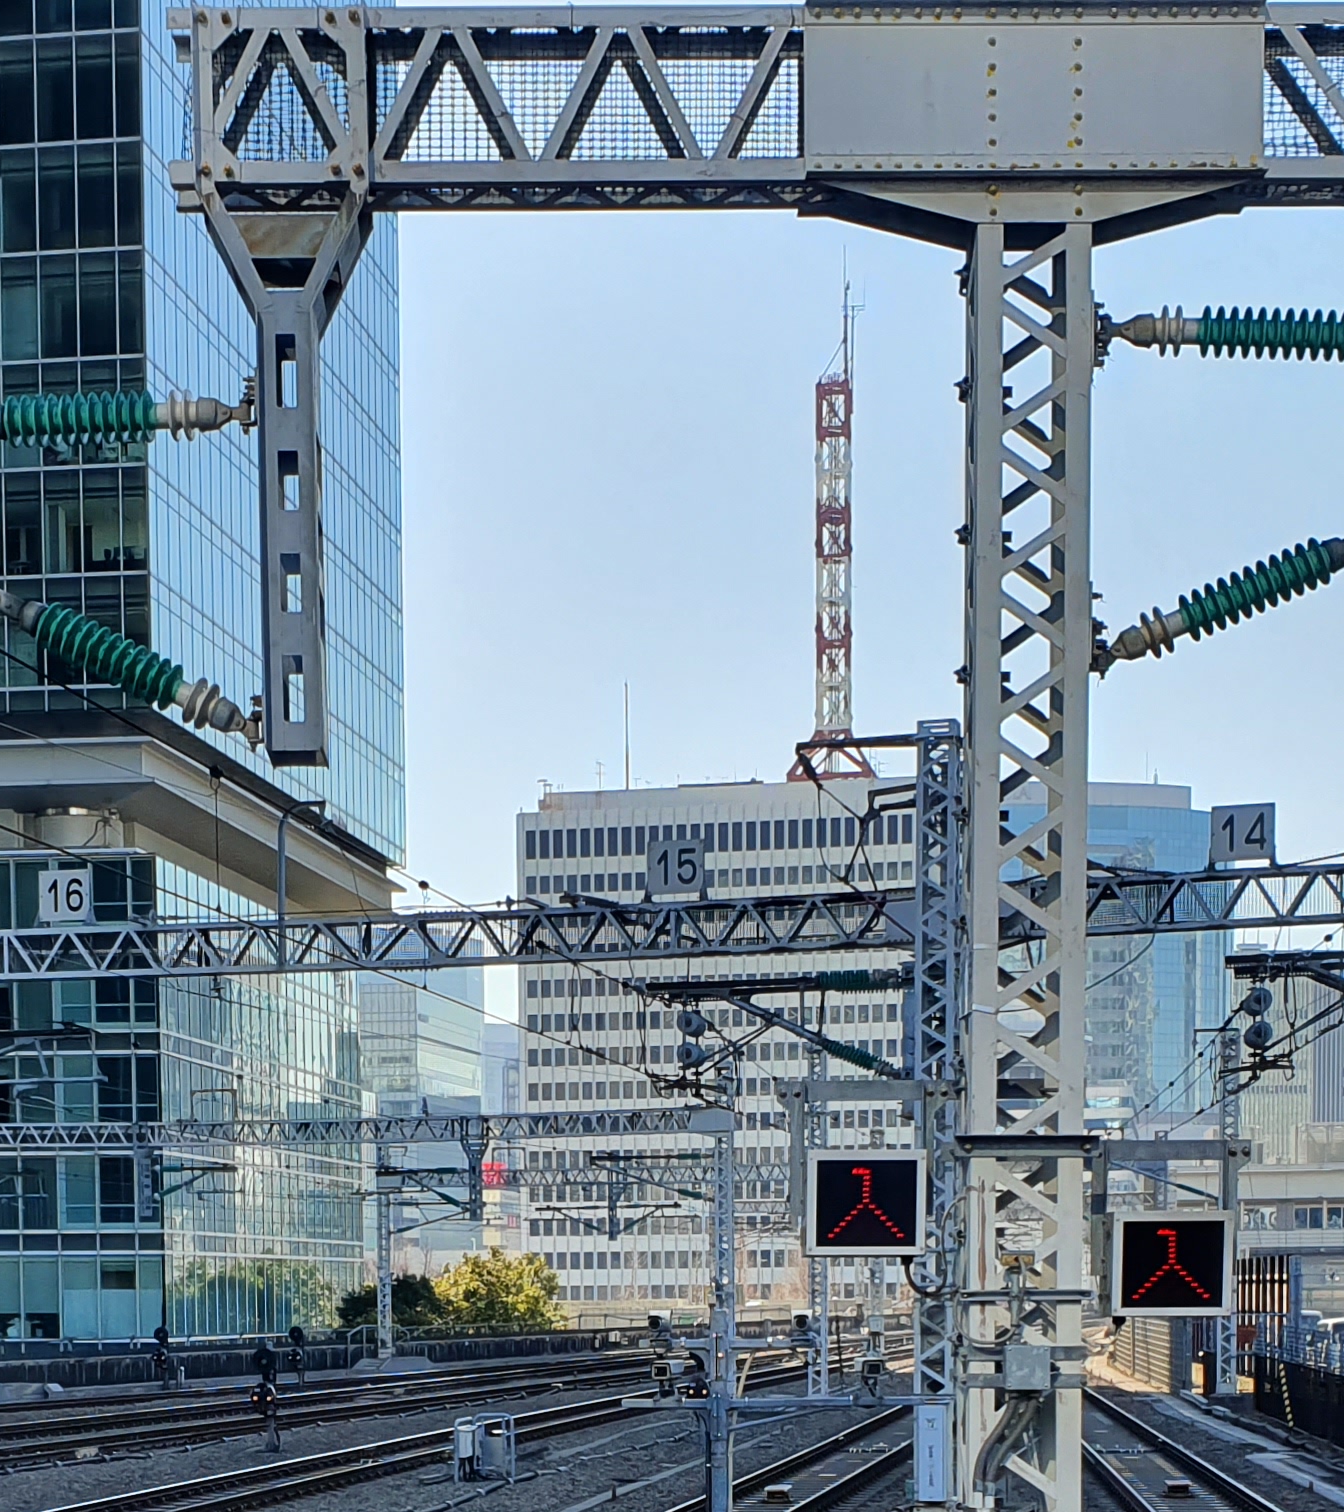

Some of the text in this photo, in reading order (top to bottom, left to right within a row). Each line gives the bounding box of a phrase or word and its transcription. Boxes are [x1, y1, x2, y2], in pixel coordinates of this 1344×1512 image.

[1221, 811, 1267, 853] 14
[657, 848, 697, 886] 15
[48, 878, 83, 913] 16
